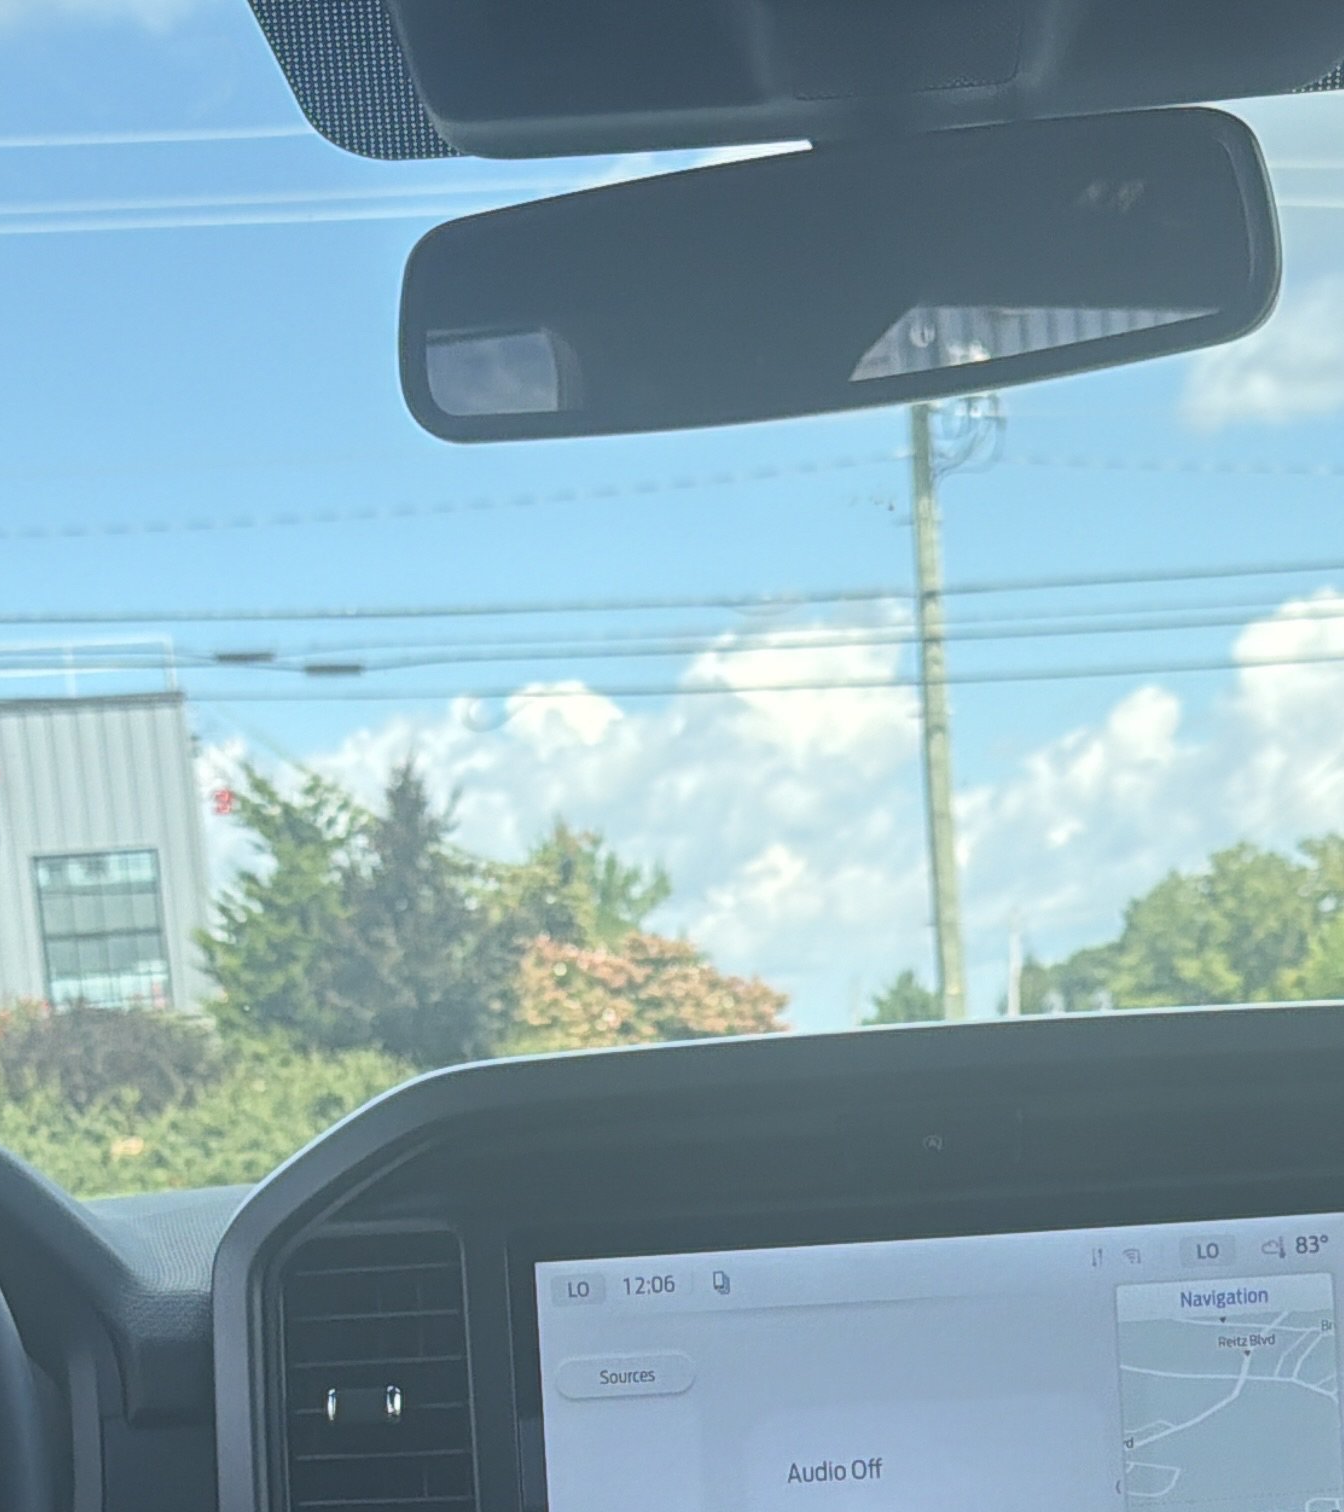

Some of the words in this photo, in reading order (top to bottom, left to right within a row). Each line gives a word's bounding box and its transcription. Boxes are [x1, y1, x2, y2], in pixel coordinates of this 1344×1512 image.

[1196, 1242, 1219, 1259] LO
[1295, 1234, 1329, 1254] 83°
[567, 1280, 590, 1298] LO
[623, 1275, 676, 1296] 12:06
[1180, 1288, 1269, 1308] Navigation
[1218, 1335, 1247, 1348] Reitz
[1249, 1334, 1276, 1346] Blvd
[599, 1369, 656, 1385] Sources
[787, 1461, 847, 1483] Audio
[851, 1457, 883, 1480] Off
